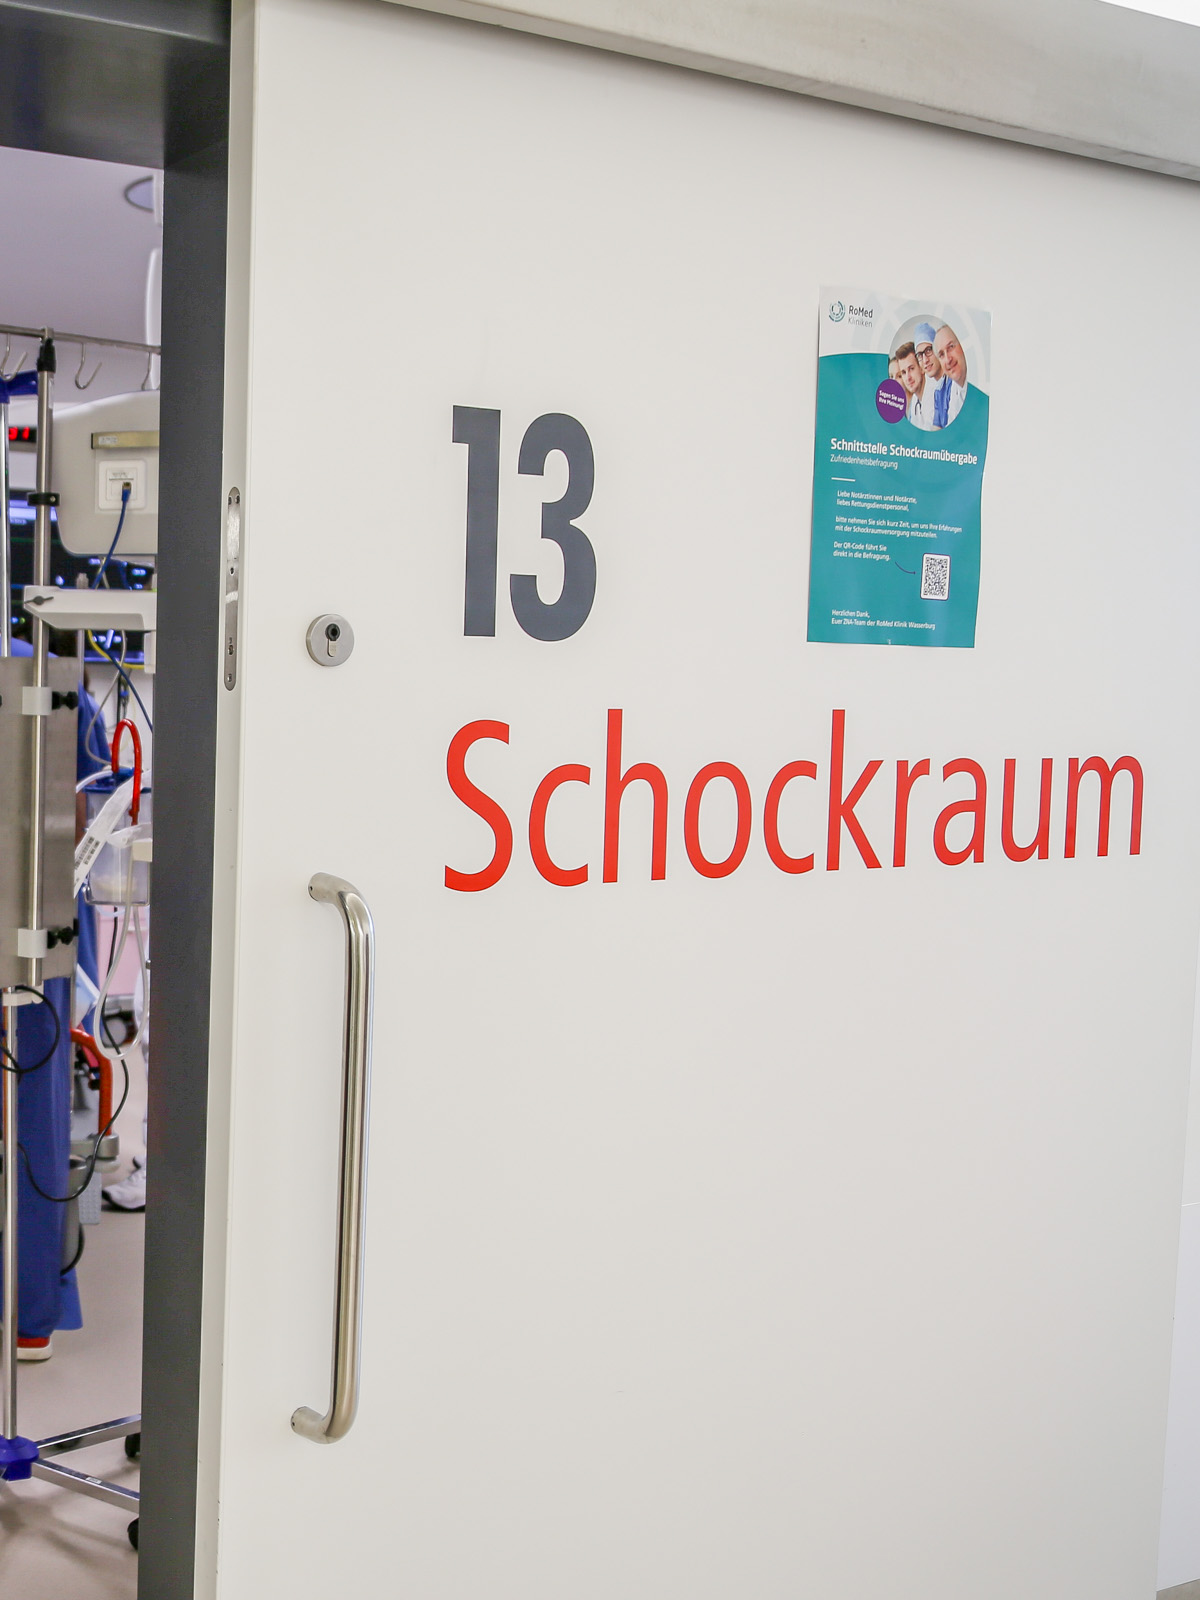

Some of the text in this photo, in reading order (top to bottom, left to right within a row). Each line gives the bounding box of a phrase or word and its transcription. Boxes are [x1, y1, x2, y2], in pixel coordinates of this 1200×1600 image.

[848, 304, 874, 319] RoMed
[848, 316, 873, 328] Kliniken
[830, 437, 978, 466] Schnittstelle Schockraumübergabe
[830, 454, 899, 470] Zufriedenheitsbefragung
[837, 490, 850, 498] Liebe
[850, 491, 882, 501] Notärztinnen
[836, 499, 850, 507] liebes
[452, 404, 597, 642] 13
[835, 515, 847, 523] bitte
[847, 517, 867, 525] nehmen
[876, 519, 886, 527] sich
[899, 520, 910, 529] Zeit,
[938, 524, 962, 534] Erfahrungen
[852, 526, 910, 538] Schockraumversorgung
[843, 542, 865, 550] QR-Code
[865, 543, 878, 551] führt
[879, 544, 887, 552] Sie
[833, 550, 848, 558] direkt
[853, 551, 862, 559] die
[831, 609, 870, 618] Herzlichen Dank,
[831, 617, 843, 625] Euer
[843, 618, 866, 626] ZNA-Team
[908, 622, 936, 631] Wasserburg
[444, 708, 1144, 892] Schockraum
